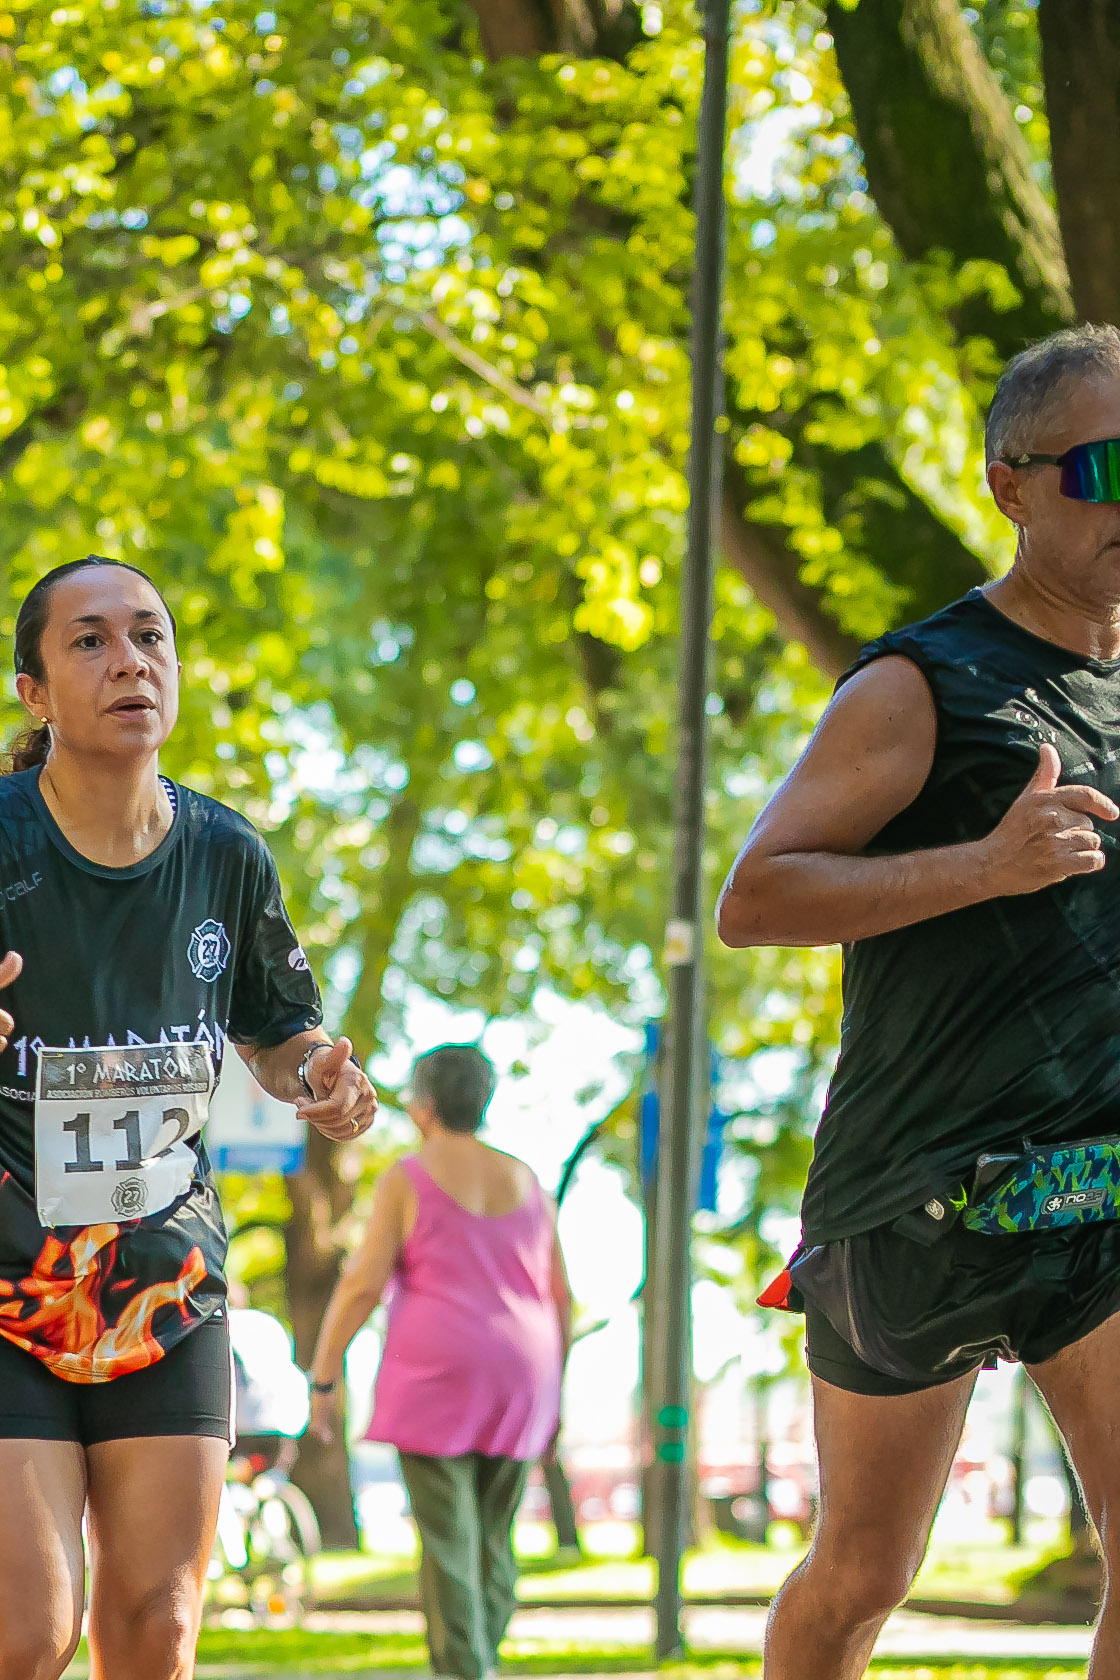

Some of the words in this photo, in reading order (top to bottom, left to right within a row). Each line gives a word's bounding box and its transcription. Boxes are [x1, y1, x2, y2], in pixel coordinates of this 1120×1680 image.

[202, 939, 218, 960] 27
[92, 1050, 191, 1084] MARATÓN
[62, 1107, 190, 1173] 112
